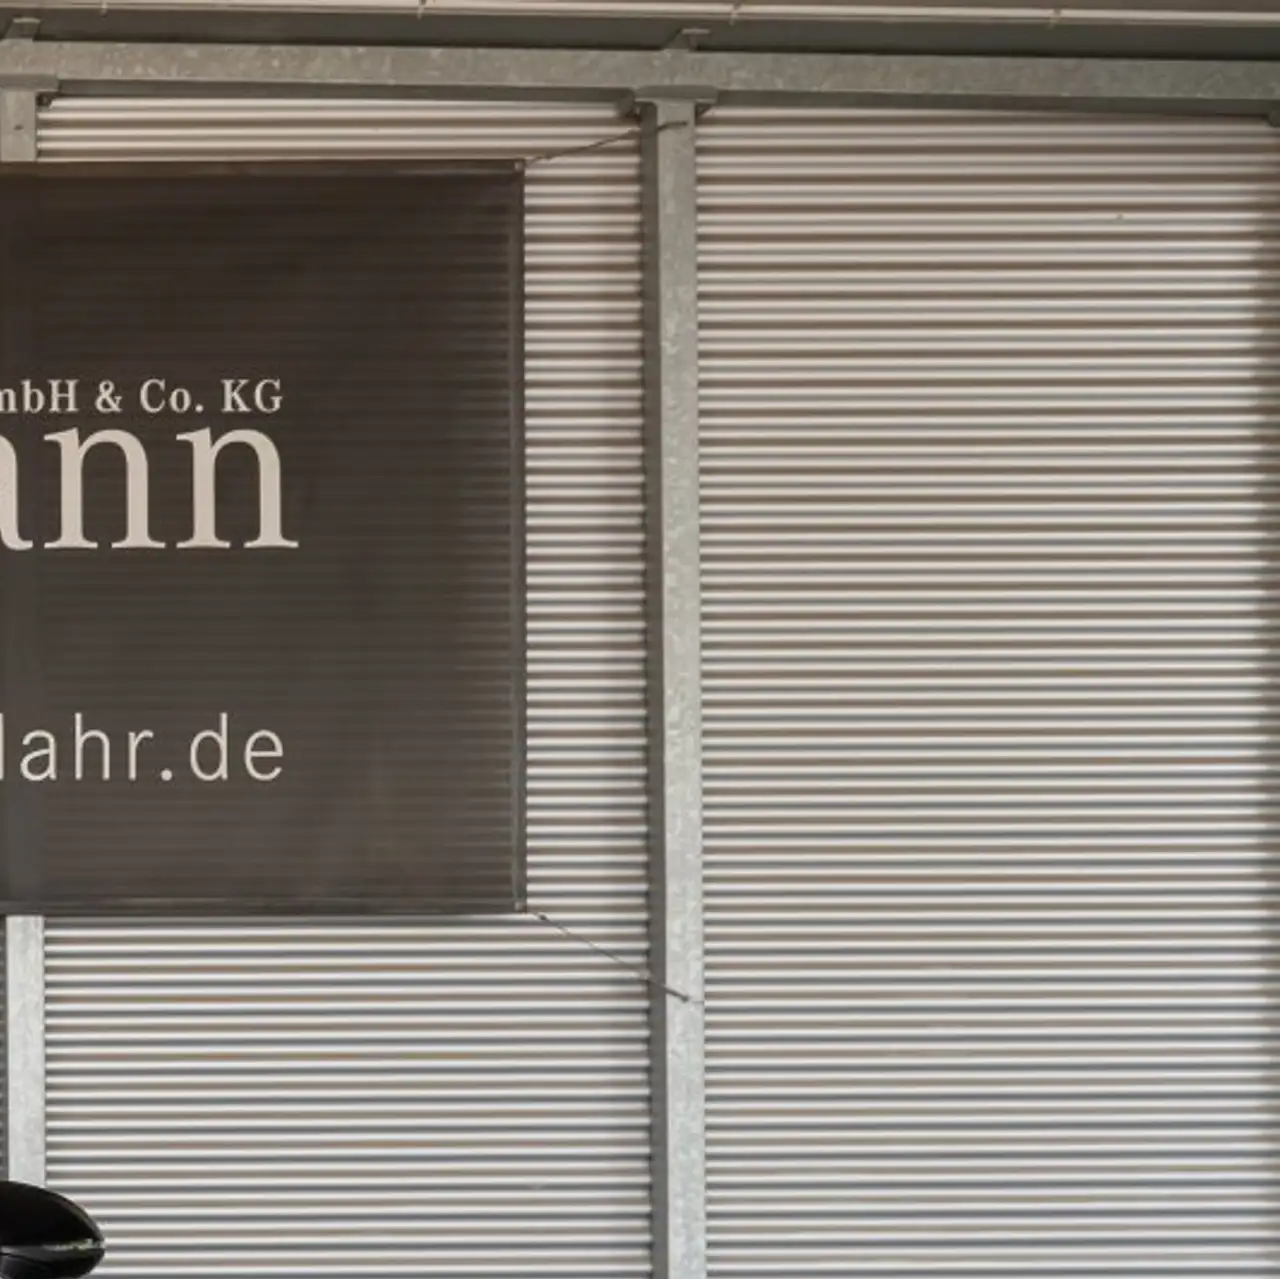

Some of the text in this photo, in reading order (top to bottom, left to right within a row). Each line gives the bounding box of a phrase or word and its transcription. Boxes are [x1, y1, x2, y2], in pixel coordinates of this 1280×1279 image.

[94, 380, 123, 413] &
[140, 378, 205, 413] Co.
[221, 378, 284, 413] KG
